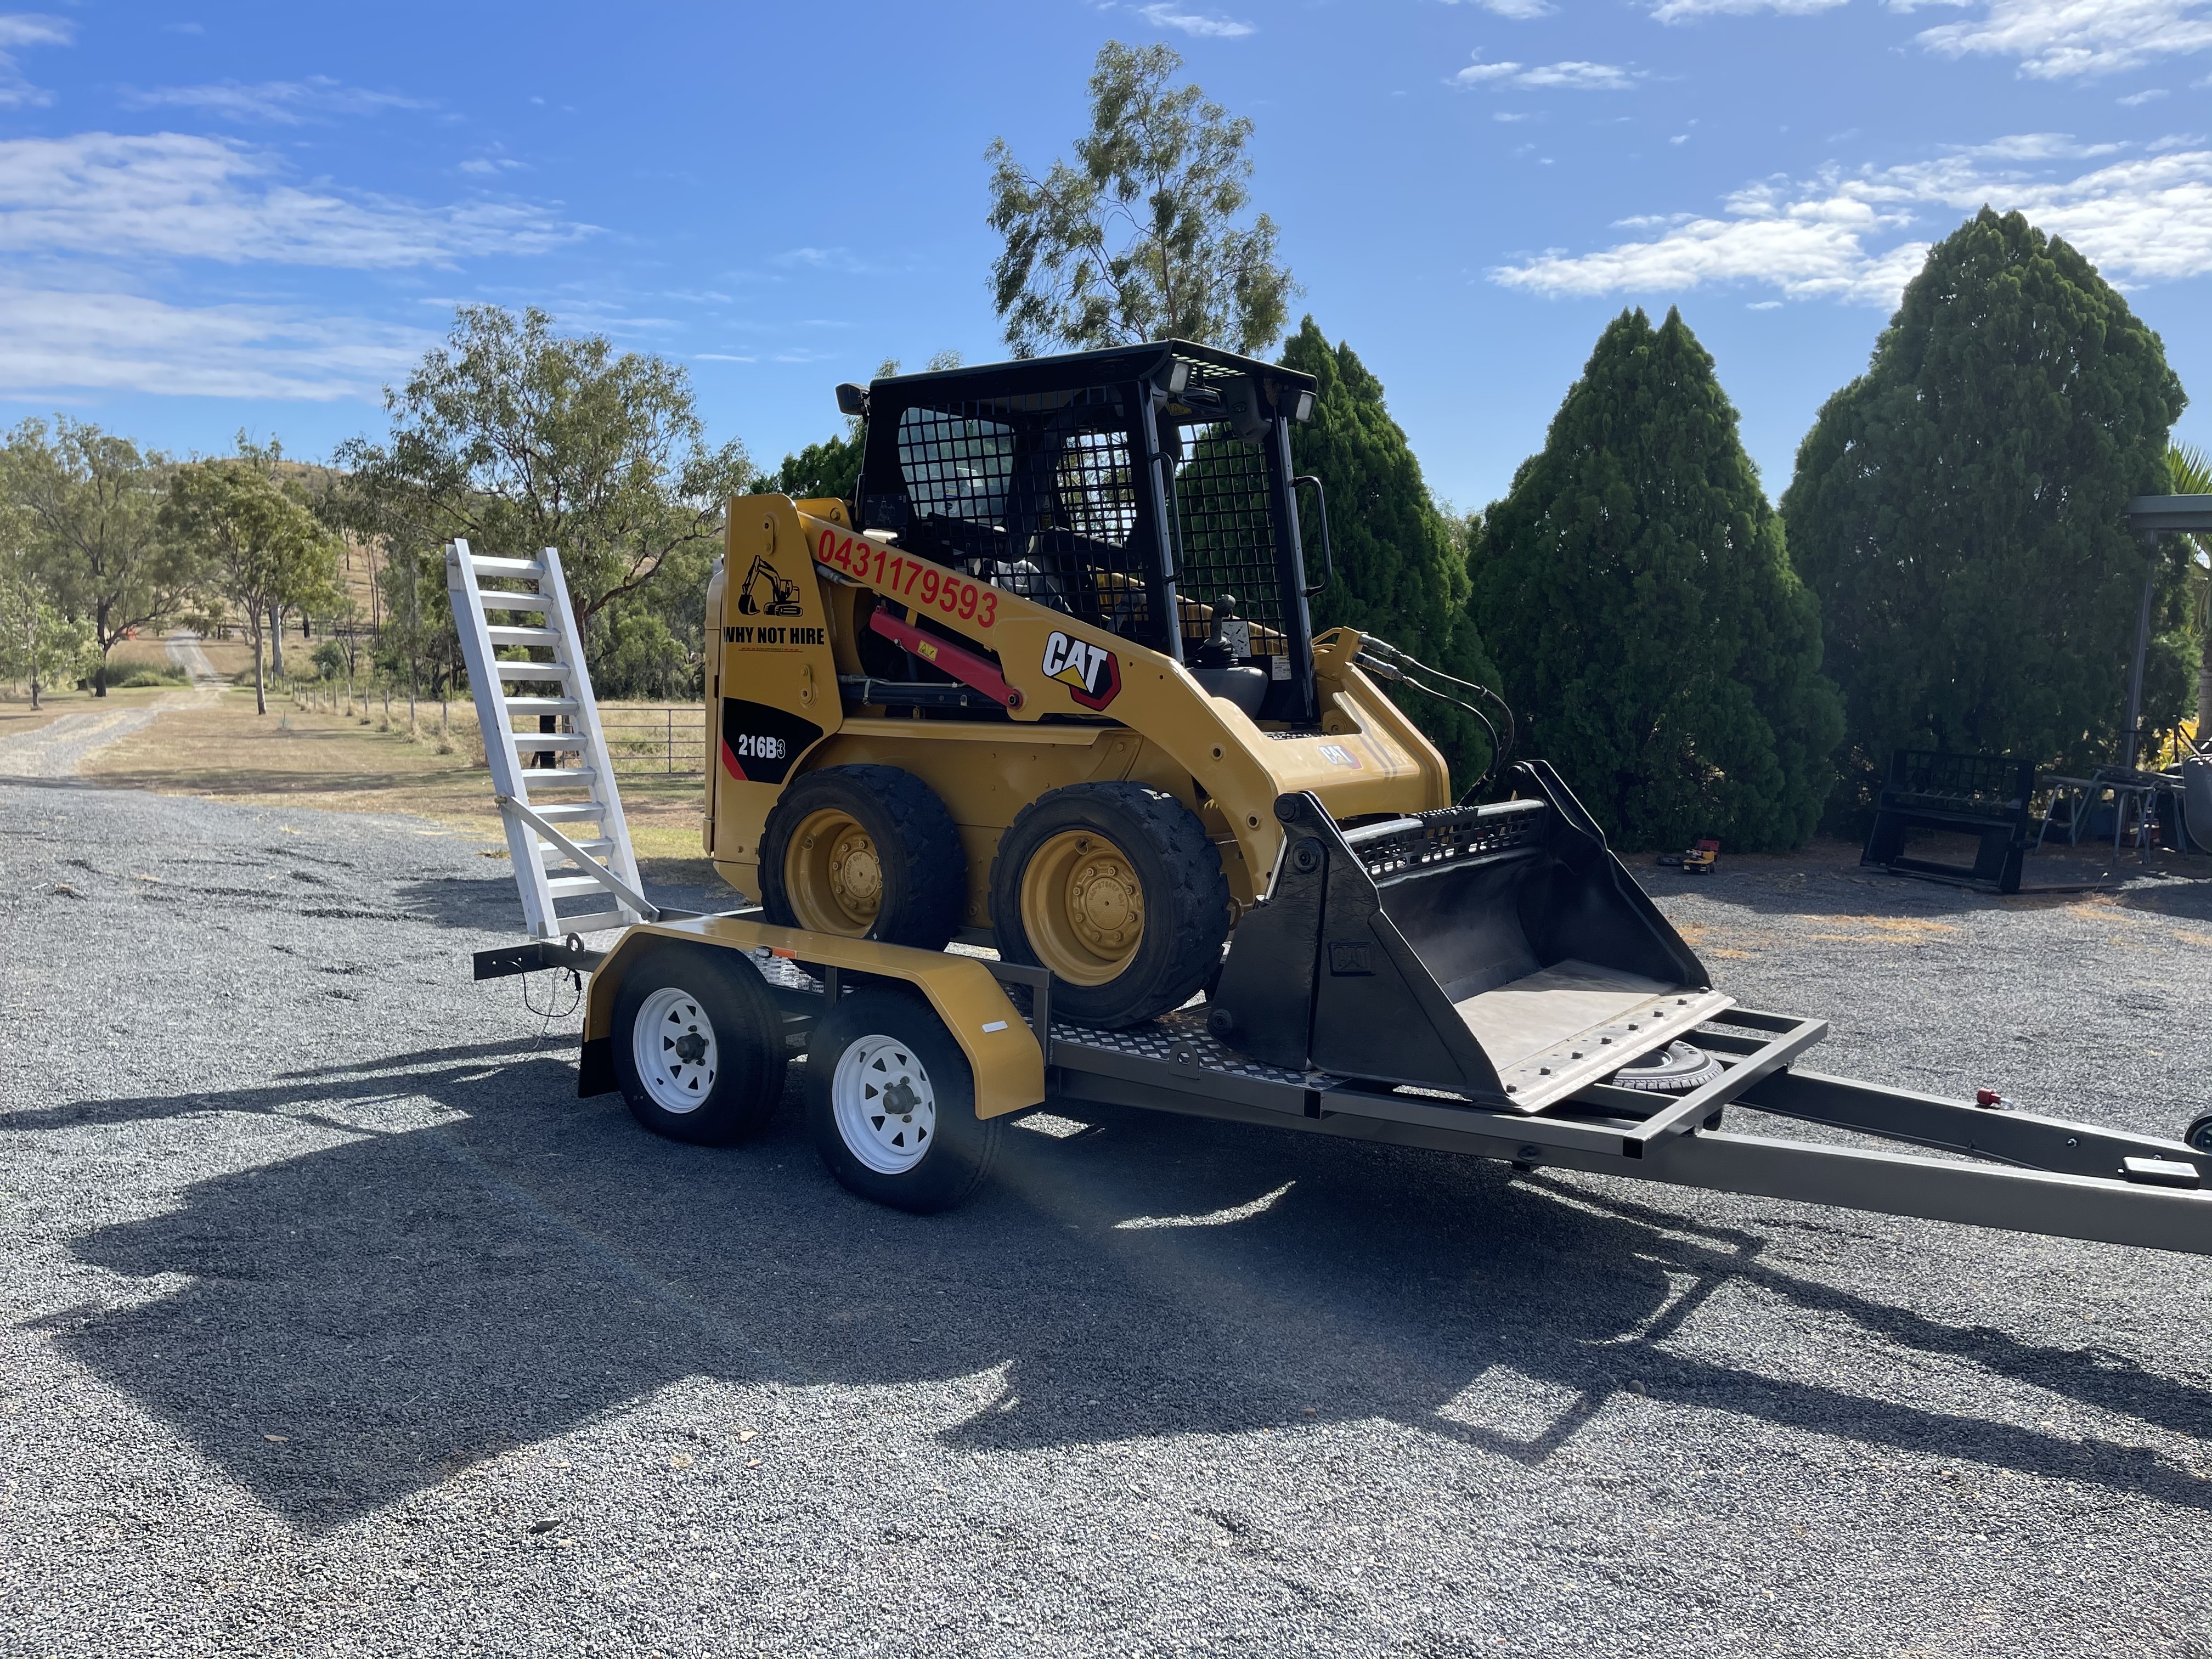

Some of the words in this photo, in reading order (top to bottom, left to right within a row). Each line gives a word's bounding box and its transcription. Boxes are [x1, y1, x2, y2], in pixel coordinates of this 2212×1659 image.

[818, 529, 997, 628] 0431179593
[723, 627, 754, 643] WHY
[758, 627, 786, 644] NOT
[790, 628, 825, 645] HIRE
[1042, 631, 1108, 693] CAT
[738, 733, 786, 759] 216B3
[1319, 746, 1353, 764] CAT
[1333, 946, 1369, 970] CAT
